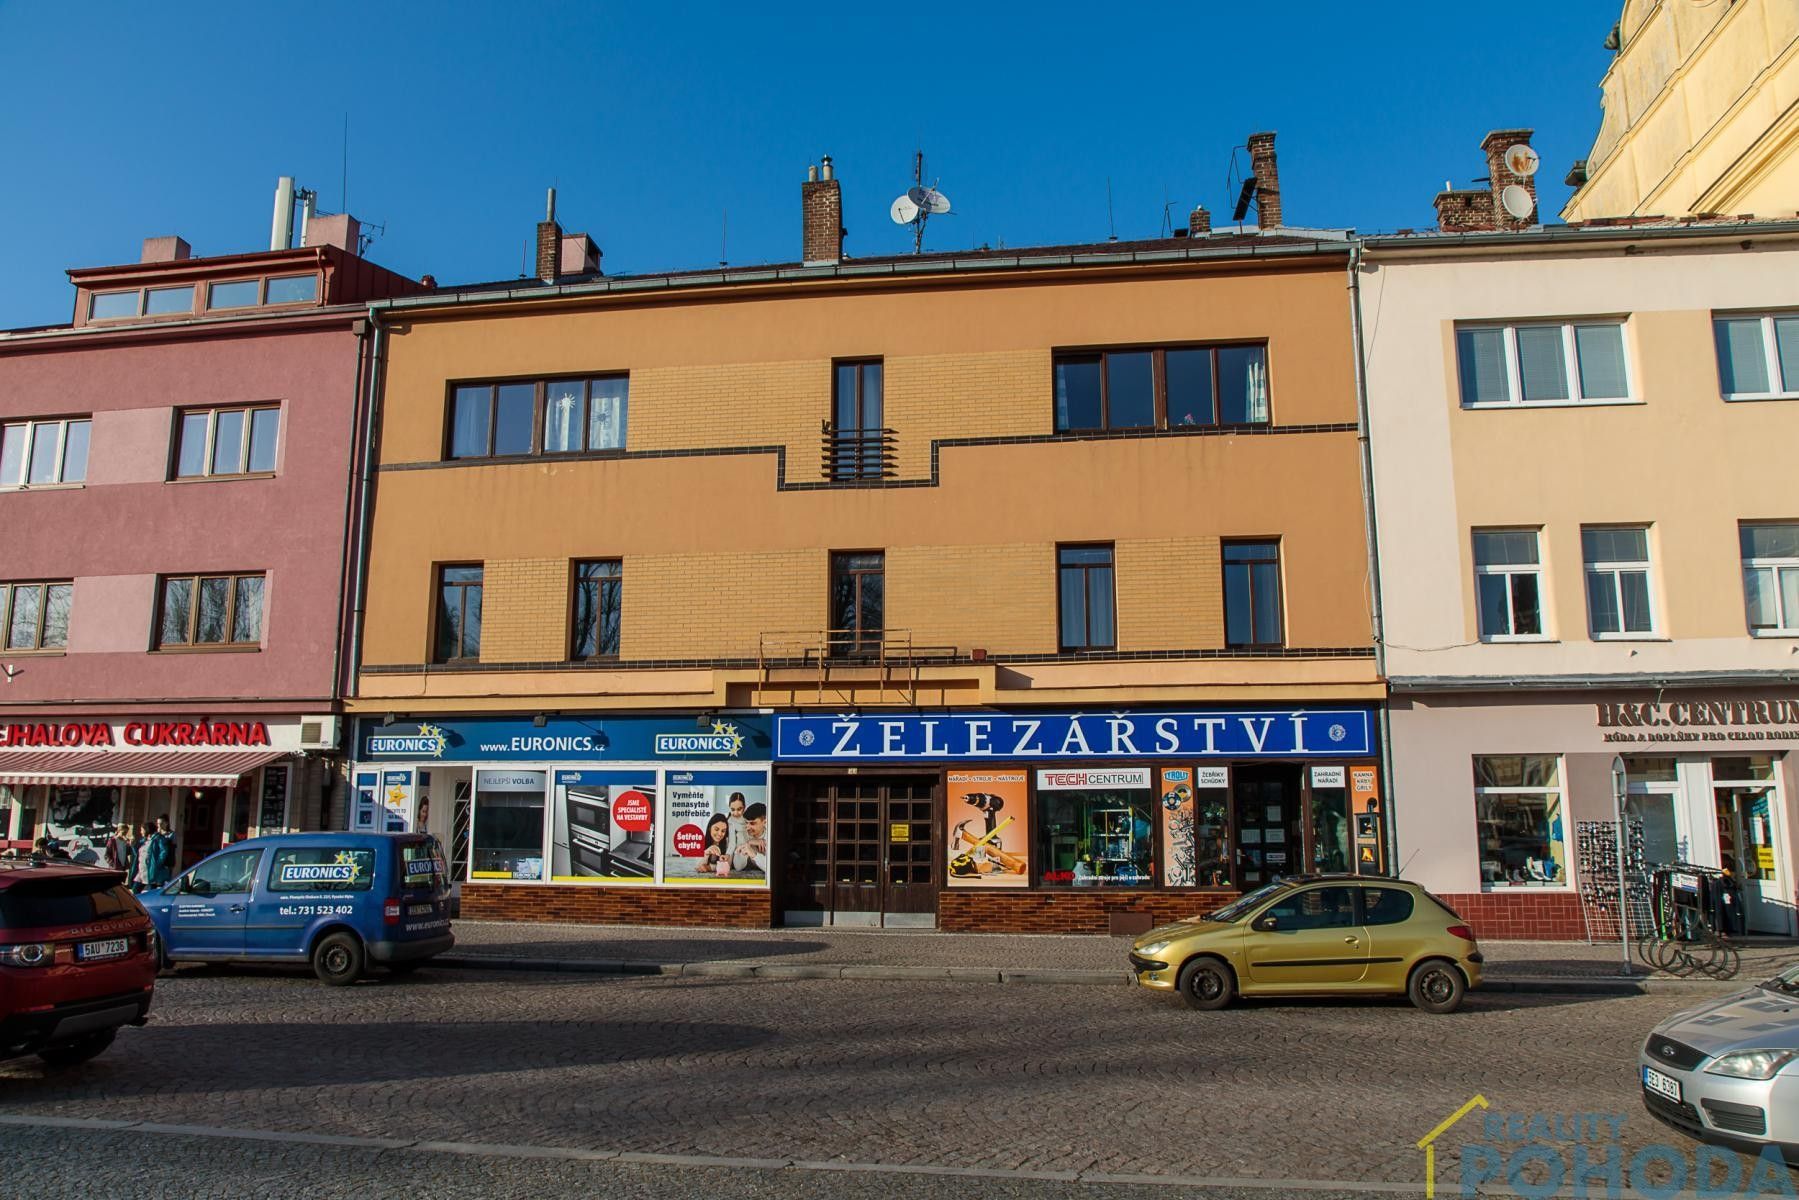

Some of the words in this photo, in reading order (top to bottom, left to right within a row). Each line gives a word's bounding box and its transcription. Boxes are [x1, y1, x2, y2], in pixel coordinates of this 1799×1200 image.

[123, 717, 268, 746] CUKRÁRNA
[831, 712, 1310, 755] ŽELEZÁŘSTVÍ
[1702, 731, 1727, 741] PRO
[371, 738, 436, 752] EURONICS
[480, 736, 605, 752] www.EURONICS.cz
[660, 737, 732, 751] EURONICS
[483, 775, 511, 785] NEJLEPŠÍ
[672, 791, 704, 800] Vyměňte
[672, 801, 710, 809] nenasytné
[671, 809, 711, 818] spotřebiče
[677, 832, 702, 840] Šetřete
[678, 842, 701, 850] chytře
[285, 866, 350, 879] EURONICS
[280, 906, 297, 915] tel.:
[298, 906, 315, 915] 731
[317, 906, 334, 915] 523
[335, 905, 353, 914] 402
